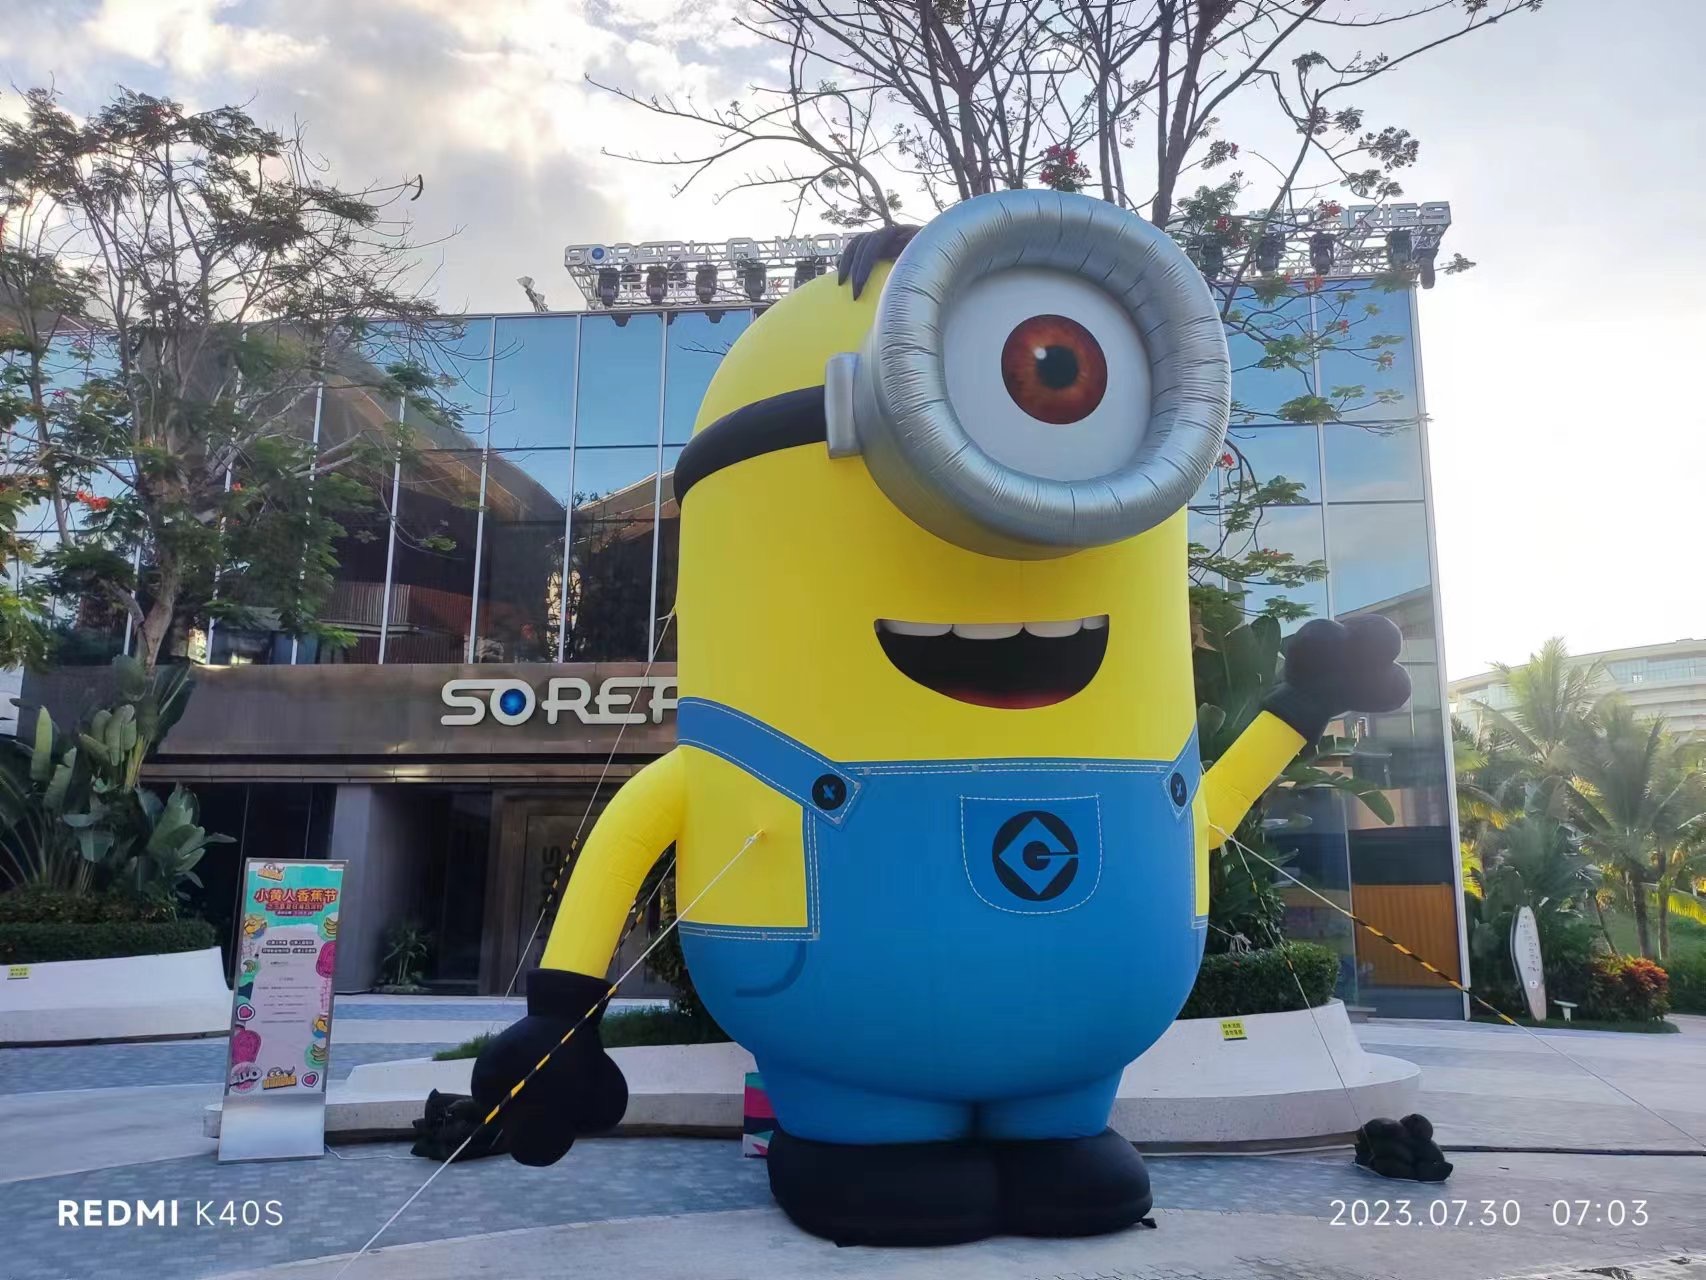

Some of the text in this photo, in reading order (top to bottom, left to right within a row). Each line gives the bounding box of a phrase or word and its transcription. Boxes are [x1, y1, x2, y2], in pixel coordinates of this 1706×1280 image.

[255, 888, 338, 903] 小黄人香蕉节
